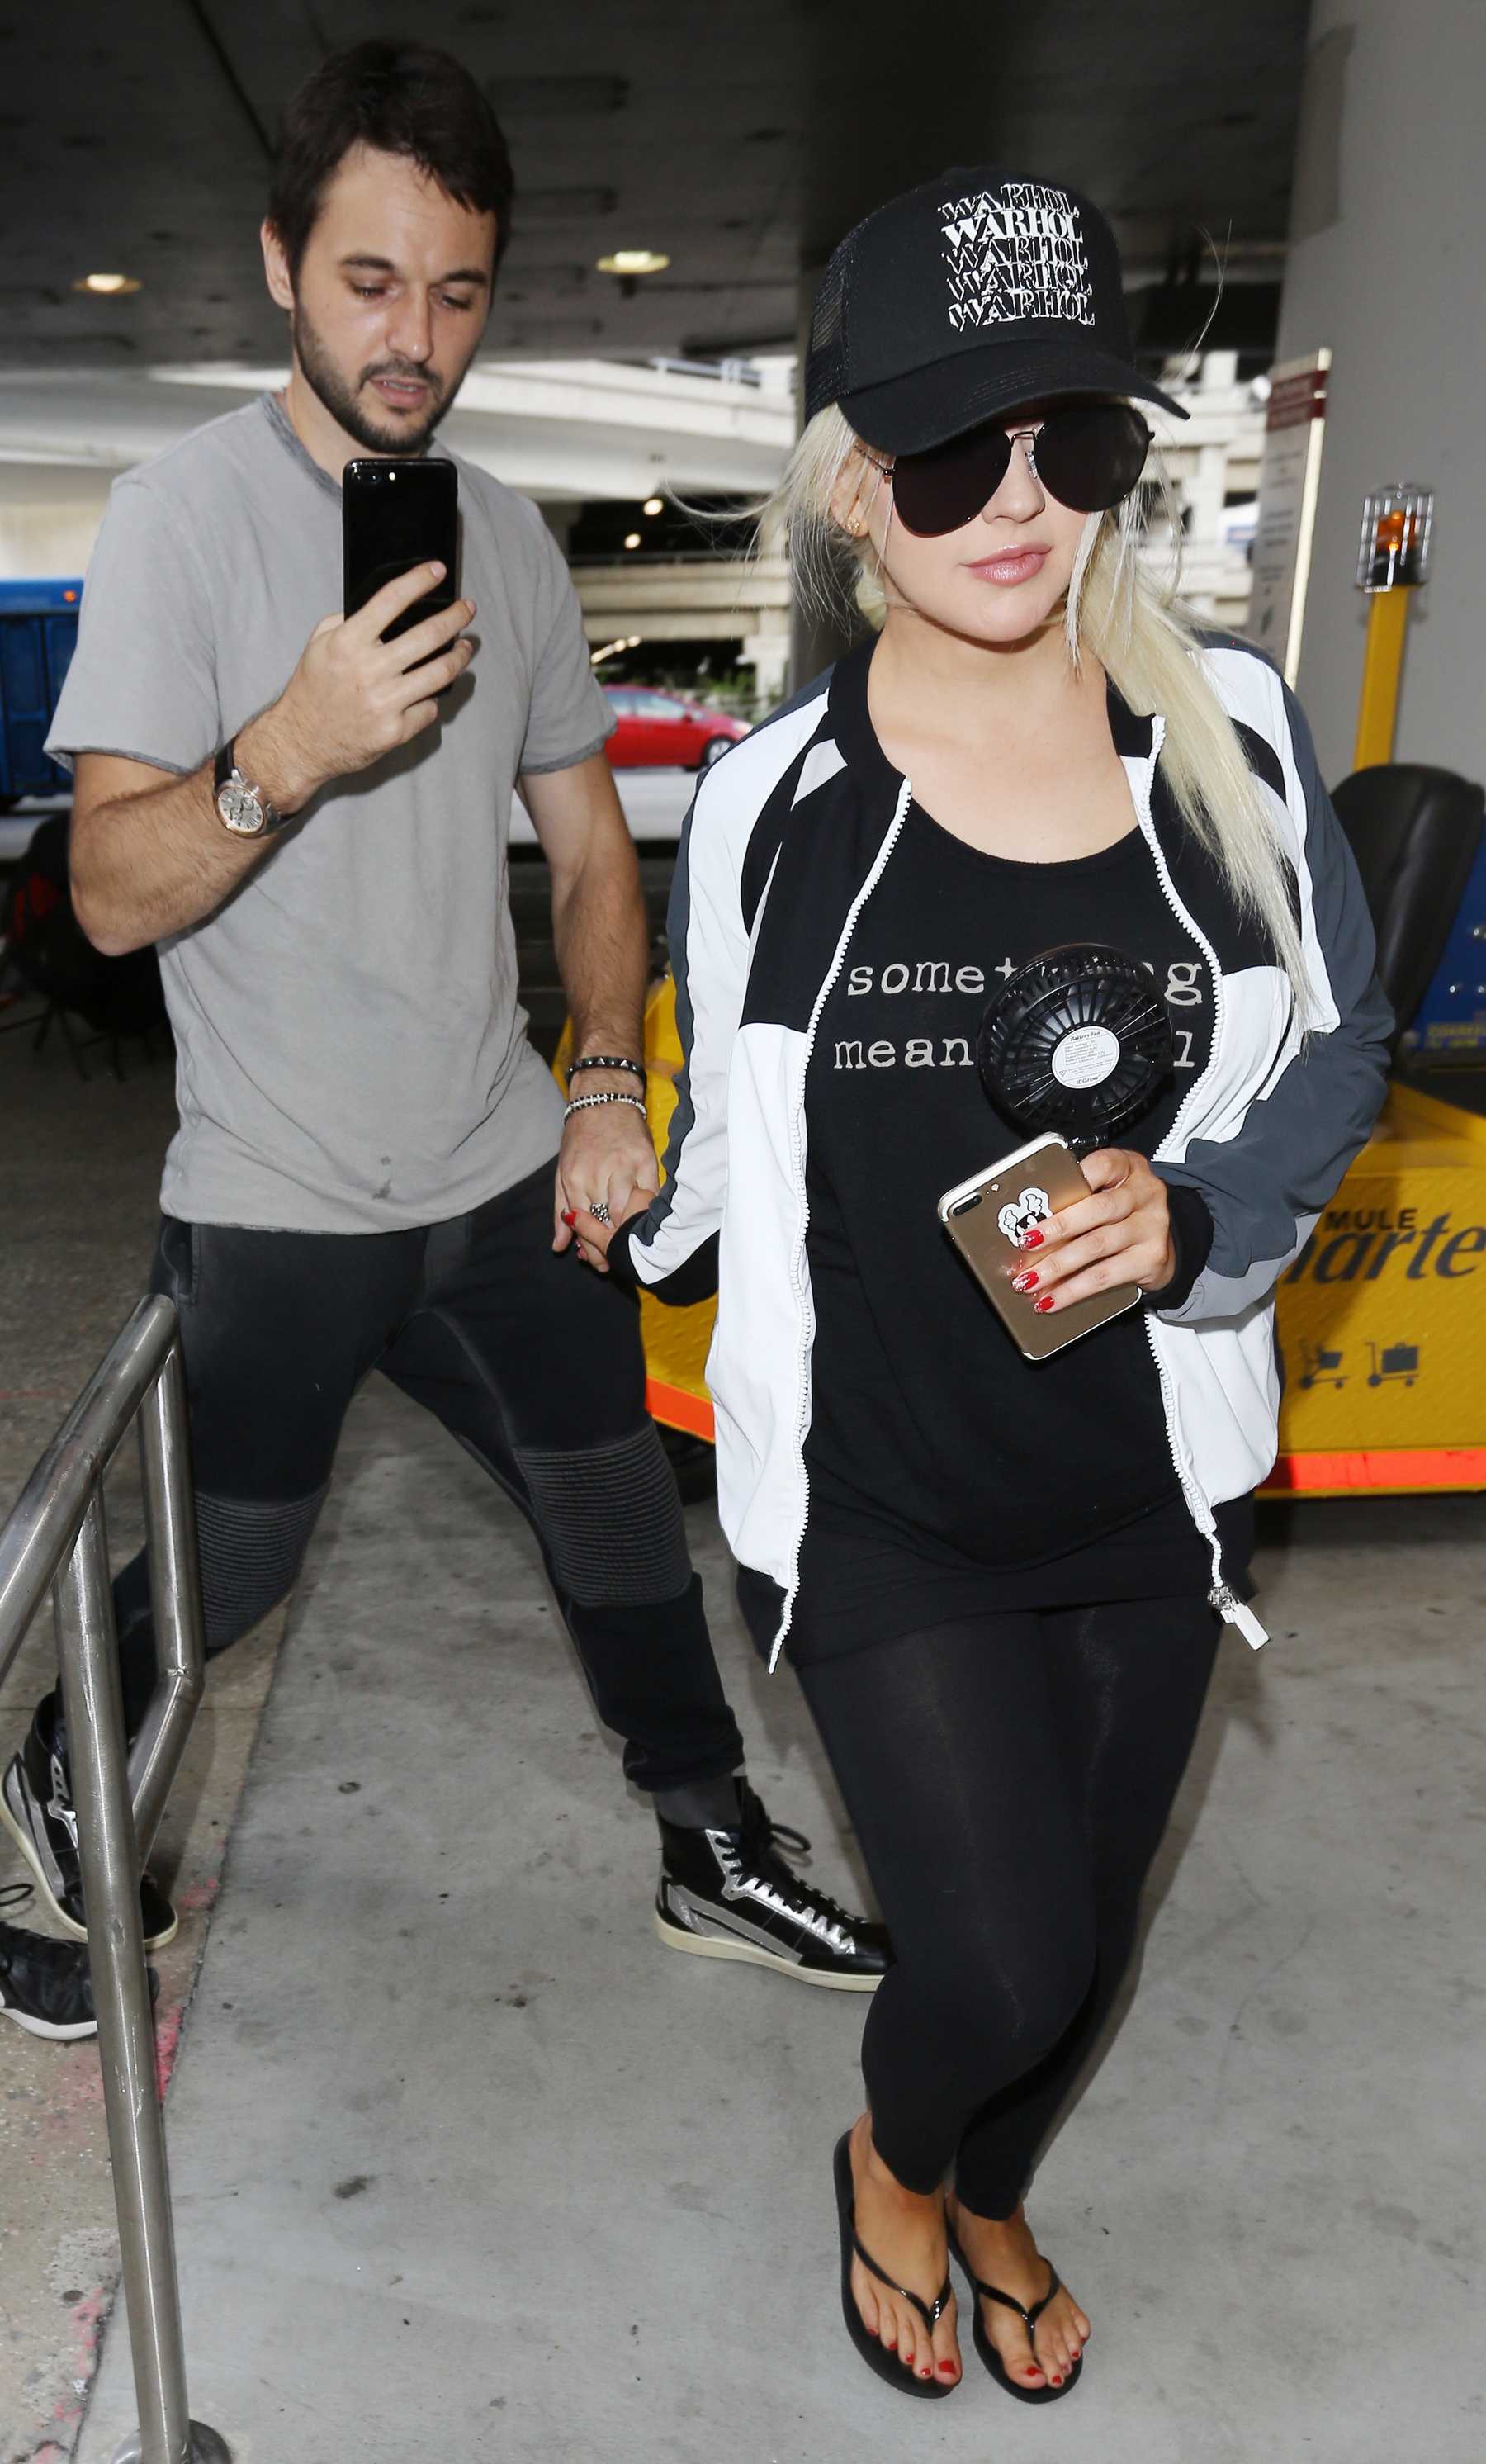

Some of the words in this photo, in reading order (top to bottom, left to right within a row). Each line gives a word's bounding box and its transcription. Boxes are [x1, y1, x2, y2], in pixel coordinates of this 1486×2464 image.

[938, 184, 1080, 220] WARHOL
[941, 207, 1083, 249] WARHOL
[942, 236, 1088, 274] WARHOL
[946, 263, 1092, 301] WARHOL
[949, 289, 1095, 332] WARHOL
[847, 957, 1203, 1007] sometg
[1323, 1208, 1418, 1230] MULE
